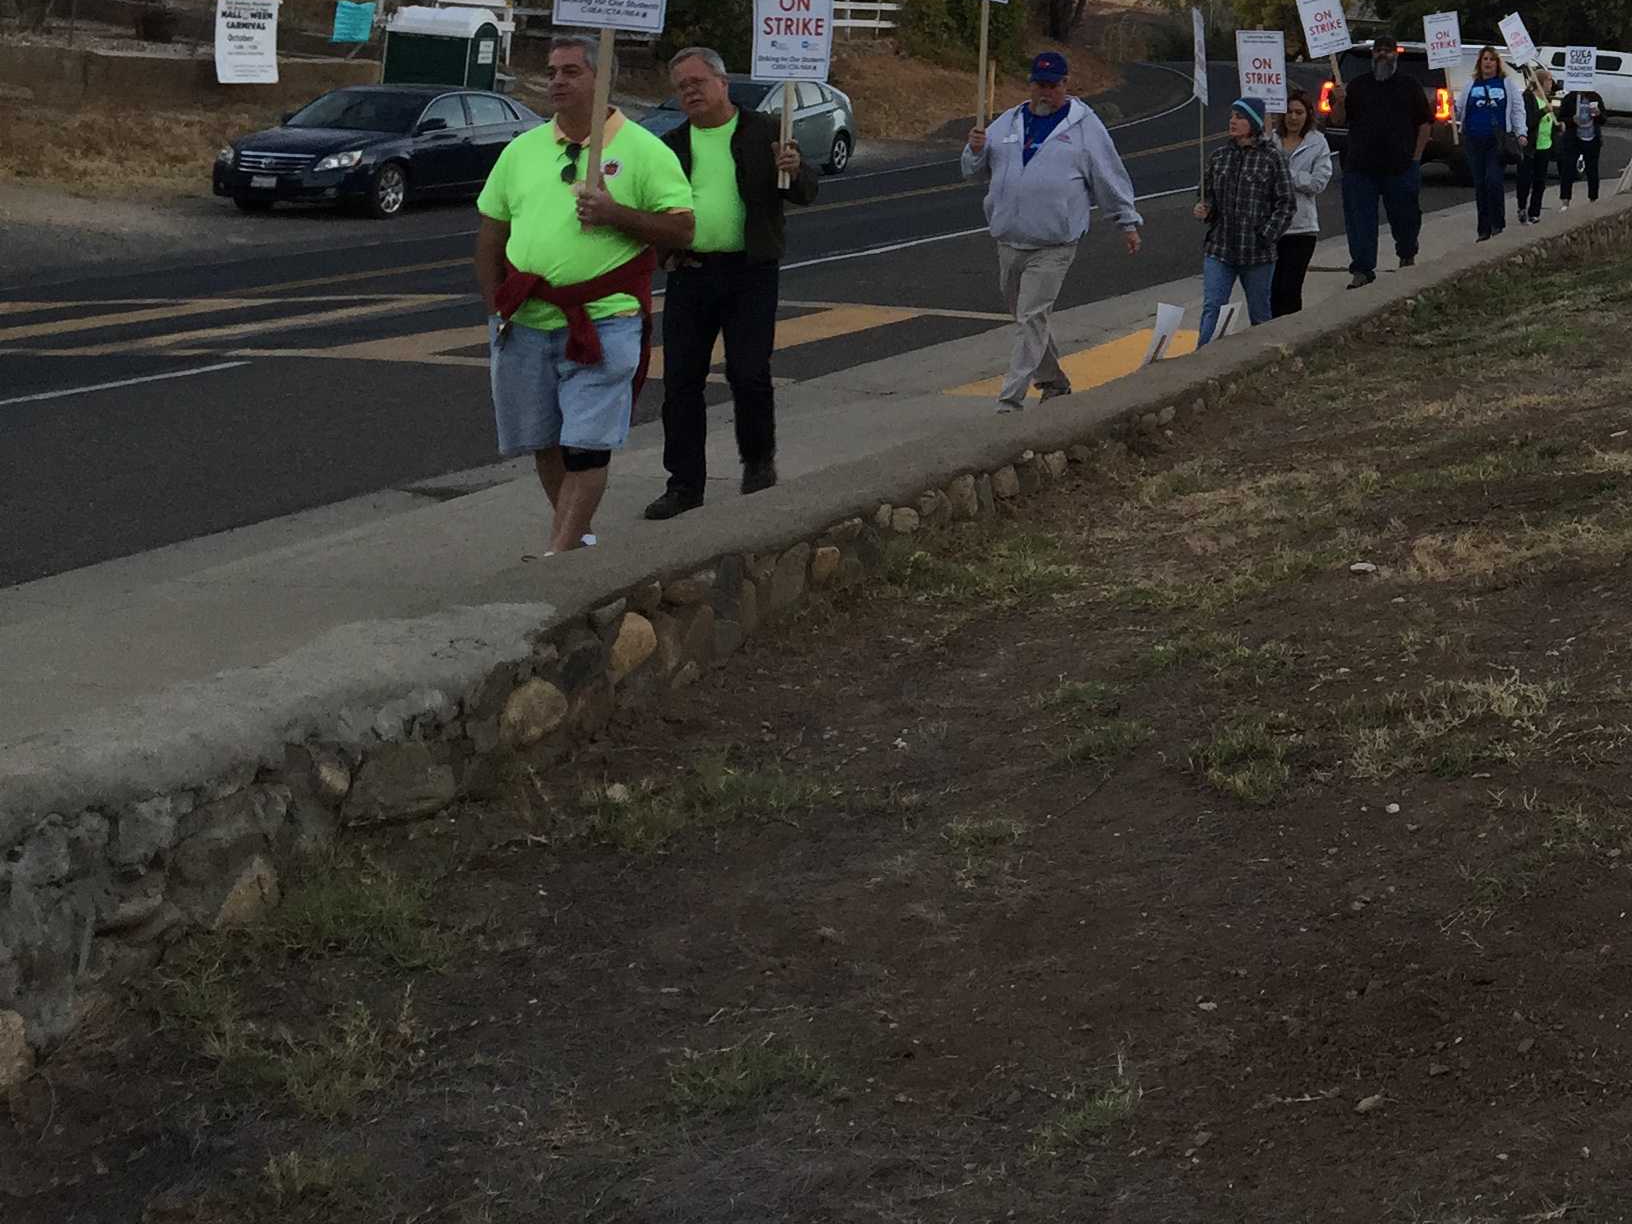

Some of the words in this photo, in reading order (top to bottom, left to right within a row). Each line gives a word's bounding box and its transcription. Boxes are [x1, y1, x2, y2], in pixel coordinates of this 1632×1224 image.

[1314, 9, 1333, 23] ON
[226, 21, 267, 30] CARNIVAL
[762, 16, 826, 37] STRIKE
[1308, 18, 1343, 37] STRIKE
[1435, 31, 1450, 41] ON
[1430, 40, 1458, 51] STRIKE
[1252, 57, 1272, 70] ON
[1245, 71, 1283, 85] STRIKE
